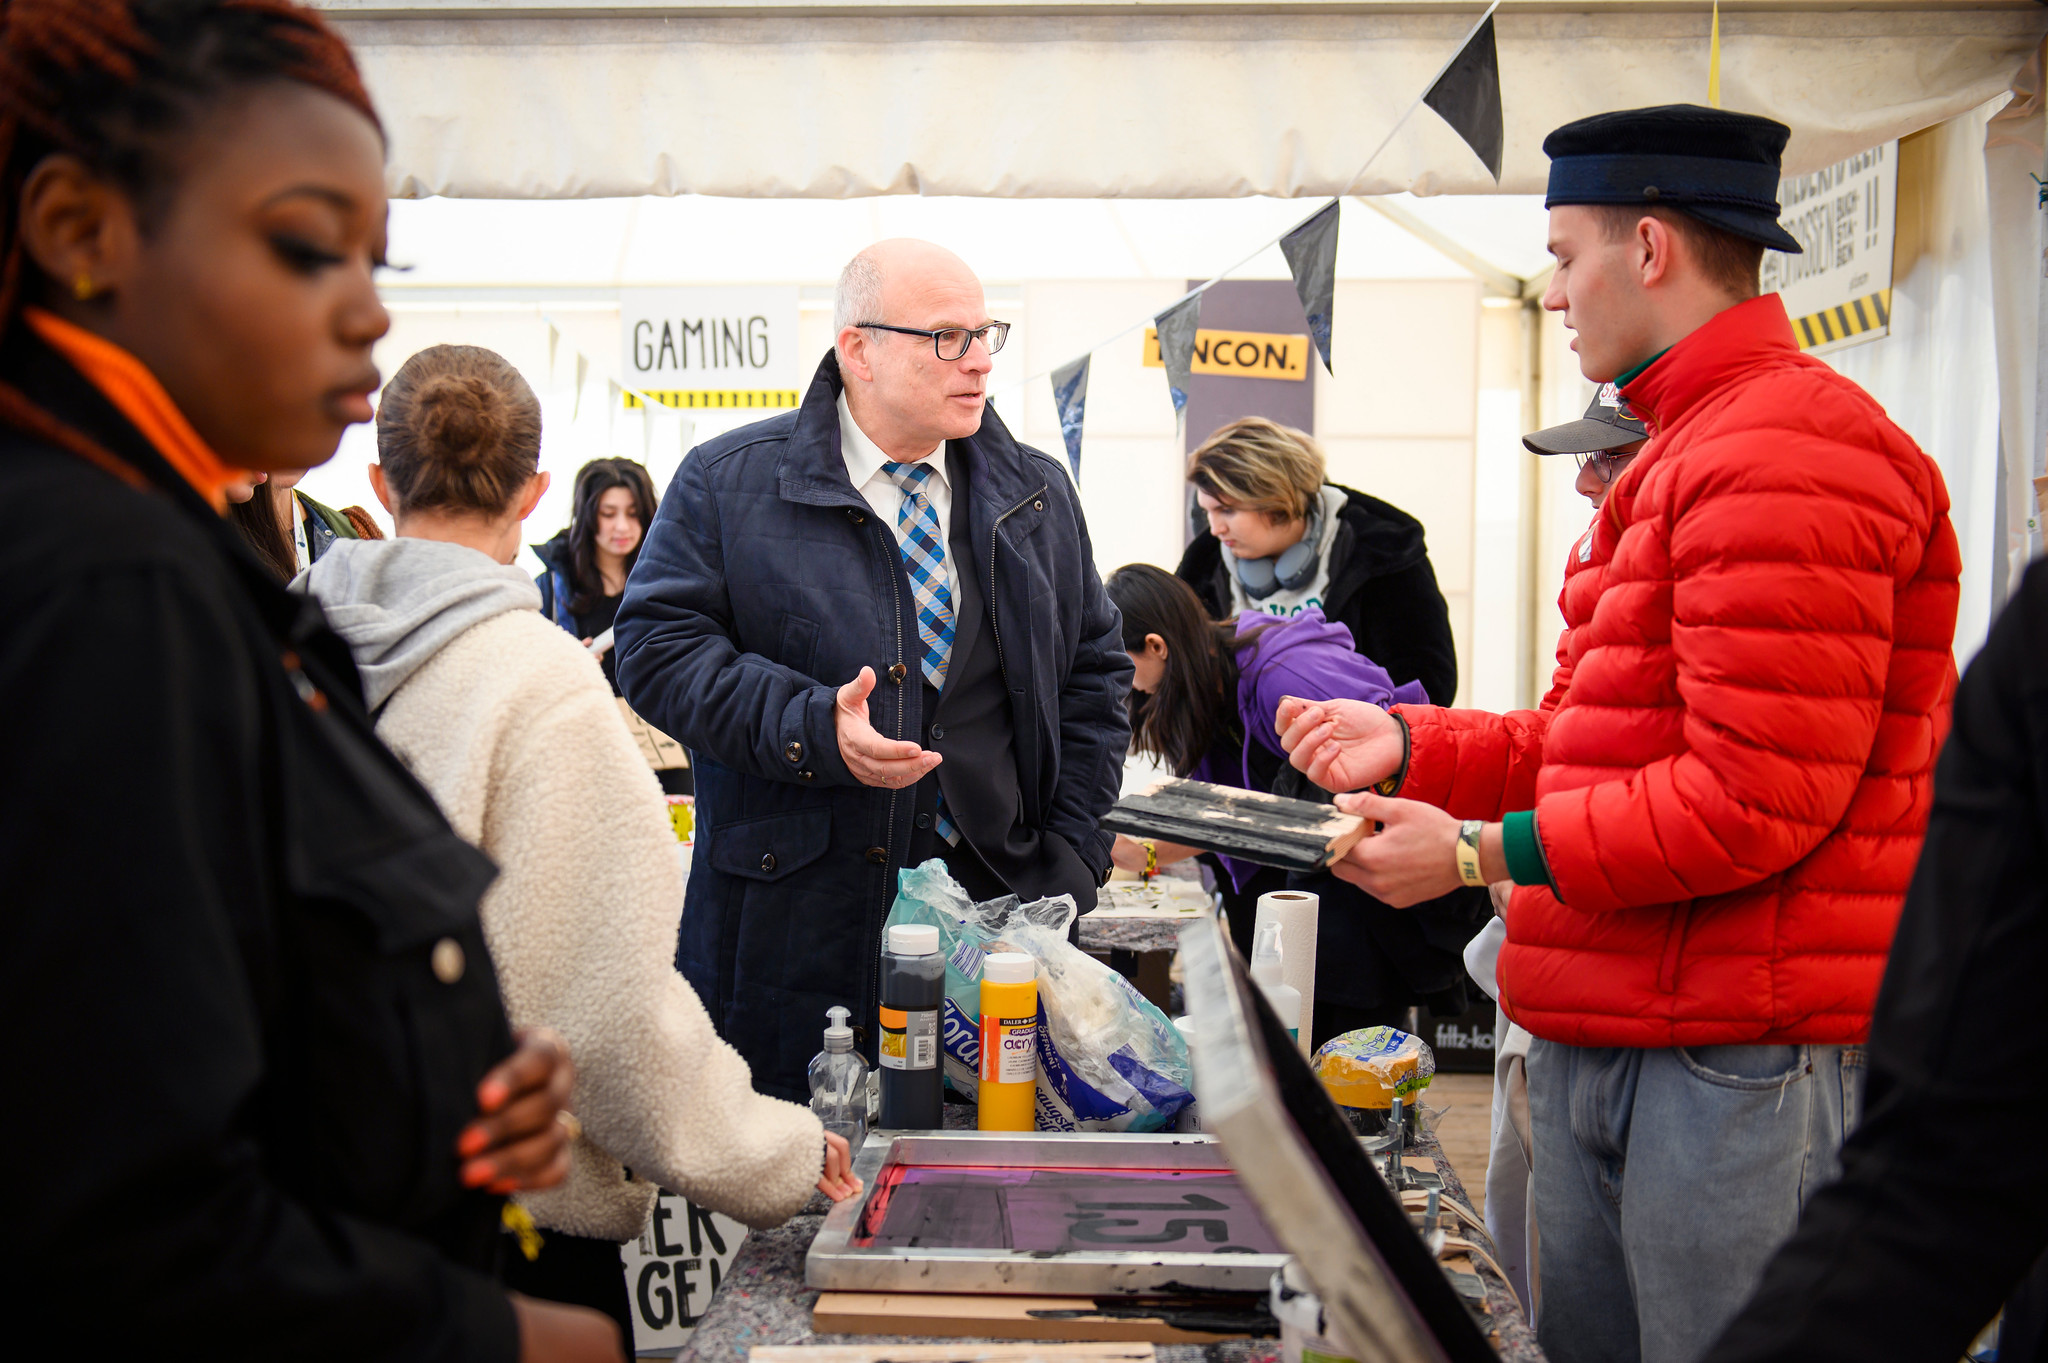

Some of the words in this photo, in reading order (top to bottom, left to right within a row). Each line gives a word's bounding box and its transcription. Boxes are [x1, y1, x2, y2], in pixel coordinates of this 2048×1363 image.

[634, 315, 769, 371] GAMING
[1153, 339, 1296, 371] TNCON.
[638, 1196, 727, 1258] ER
